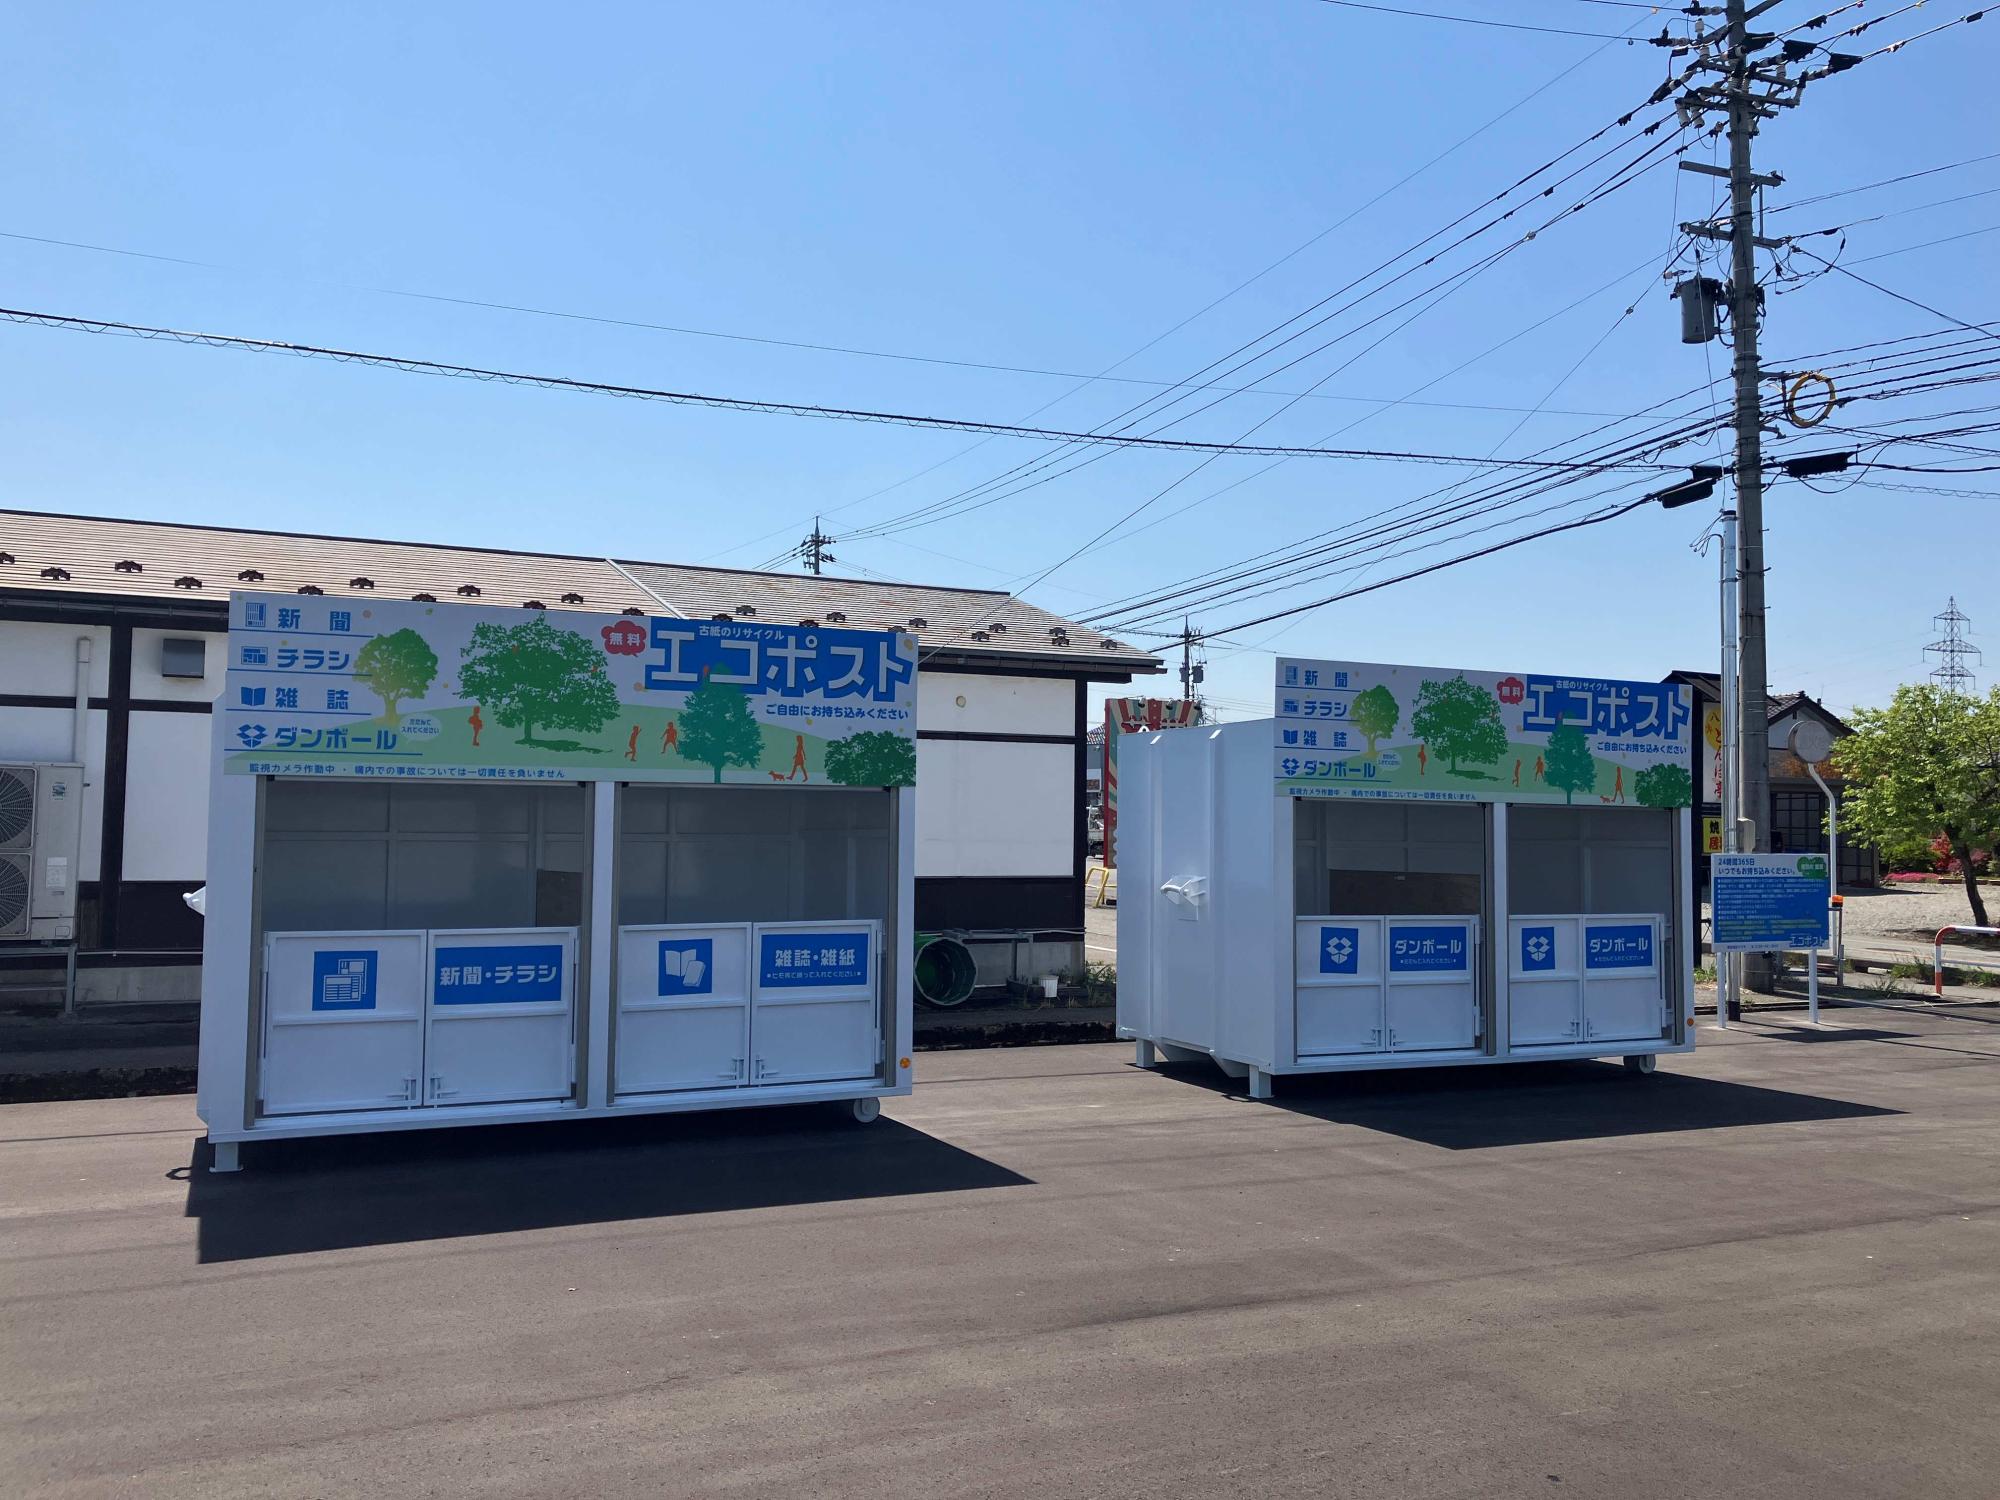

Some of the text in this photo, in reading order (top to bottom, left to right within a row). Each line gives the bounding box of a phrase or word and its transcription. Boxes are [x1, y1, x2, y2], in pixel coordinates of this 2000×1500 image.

[278, 607, 351, 632] 新聞
[609, 632, 641, 647] 無料
[699, 625, 785, 641] 古紙のリサイクル
[276, 649, 350, 671] チラシ
[651, 630, 904, 693] エコポスト
[1304, 670, 1348, 688] 新聞
[275, 686, 349, 711] 雑誌
[766, 703, 908, 720] ご自由にお持ち込みください
[1303, 700, 1347, 717] チラシ
[1526, 684, 1684, 733] エコポスト
[274, 727, 397, 750] ダンボール
[1303, 730, 1347, 748] 雑誌
[1303, 759, 1376, 778] ダンボール
[1395, 939, 1462, 955] ダンボール
[1590, 937, 1648, 953] ダンボール
[440, 965, 557, 986] 新聞・チラシ
